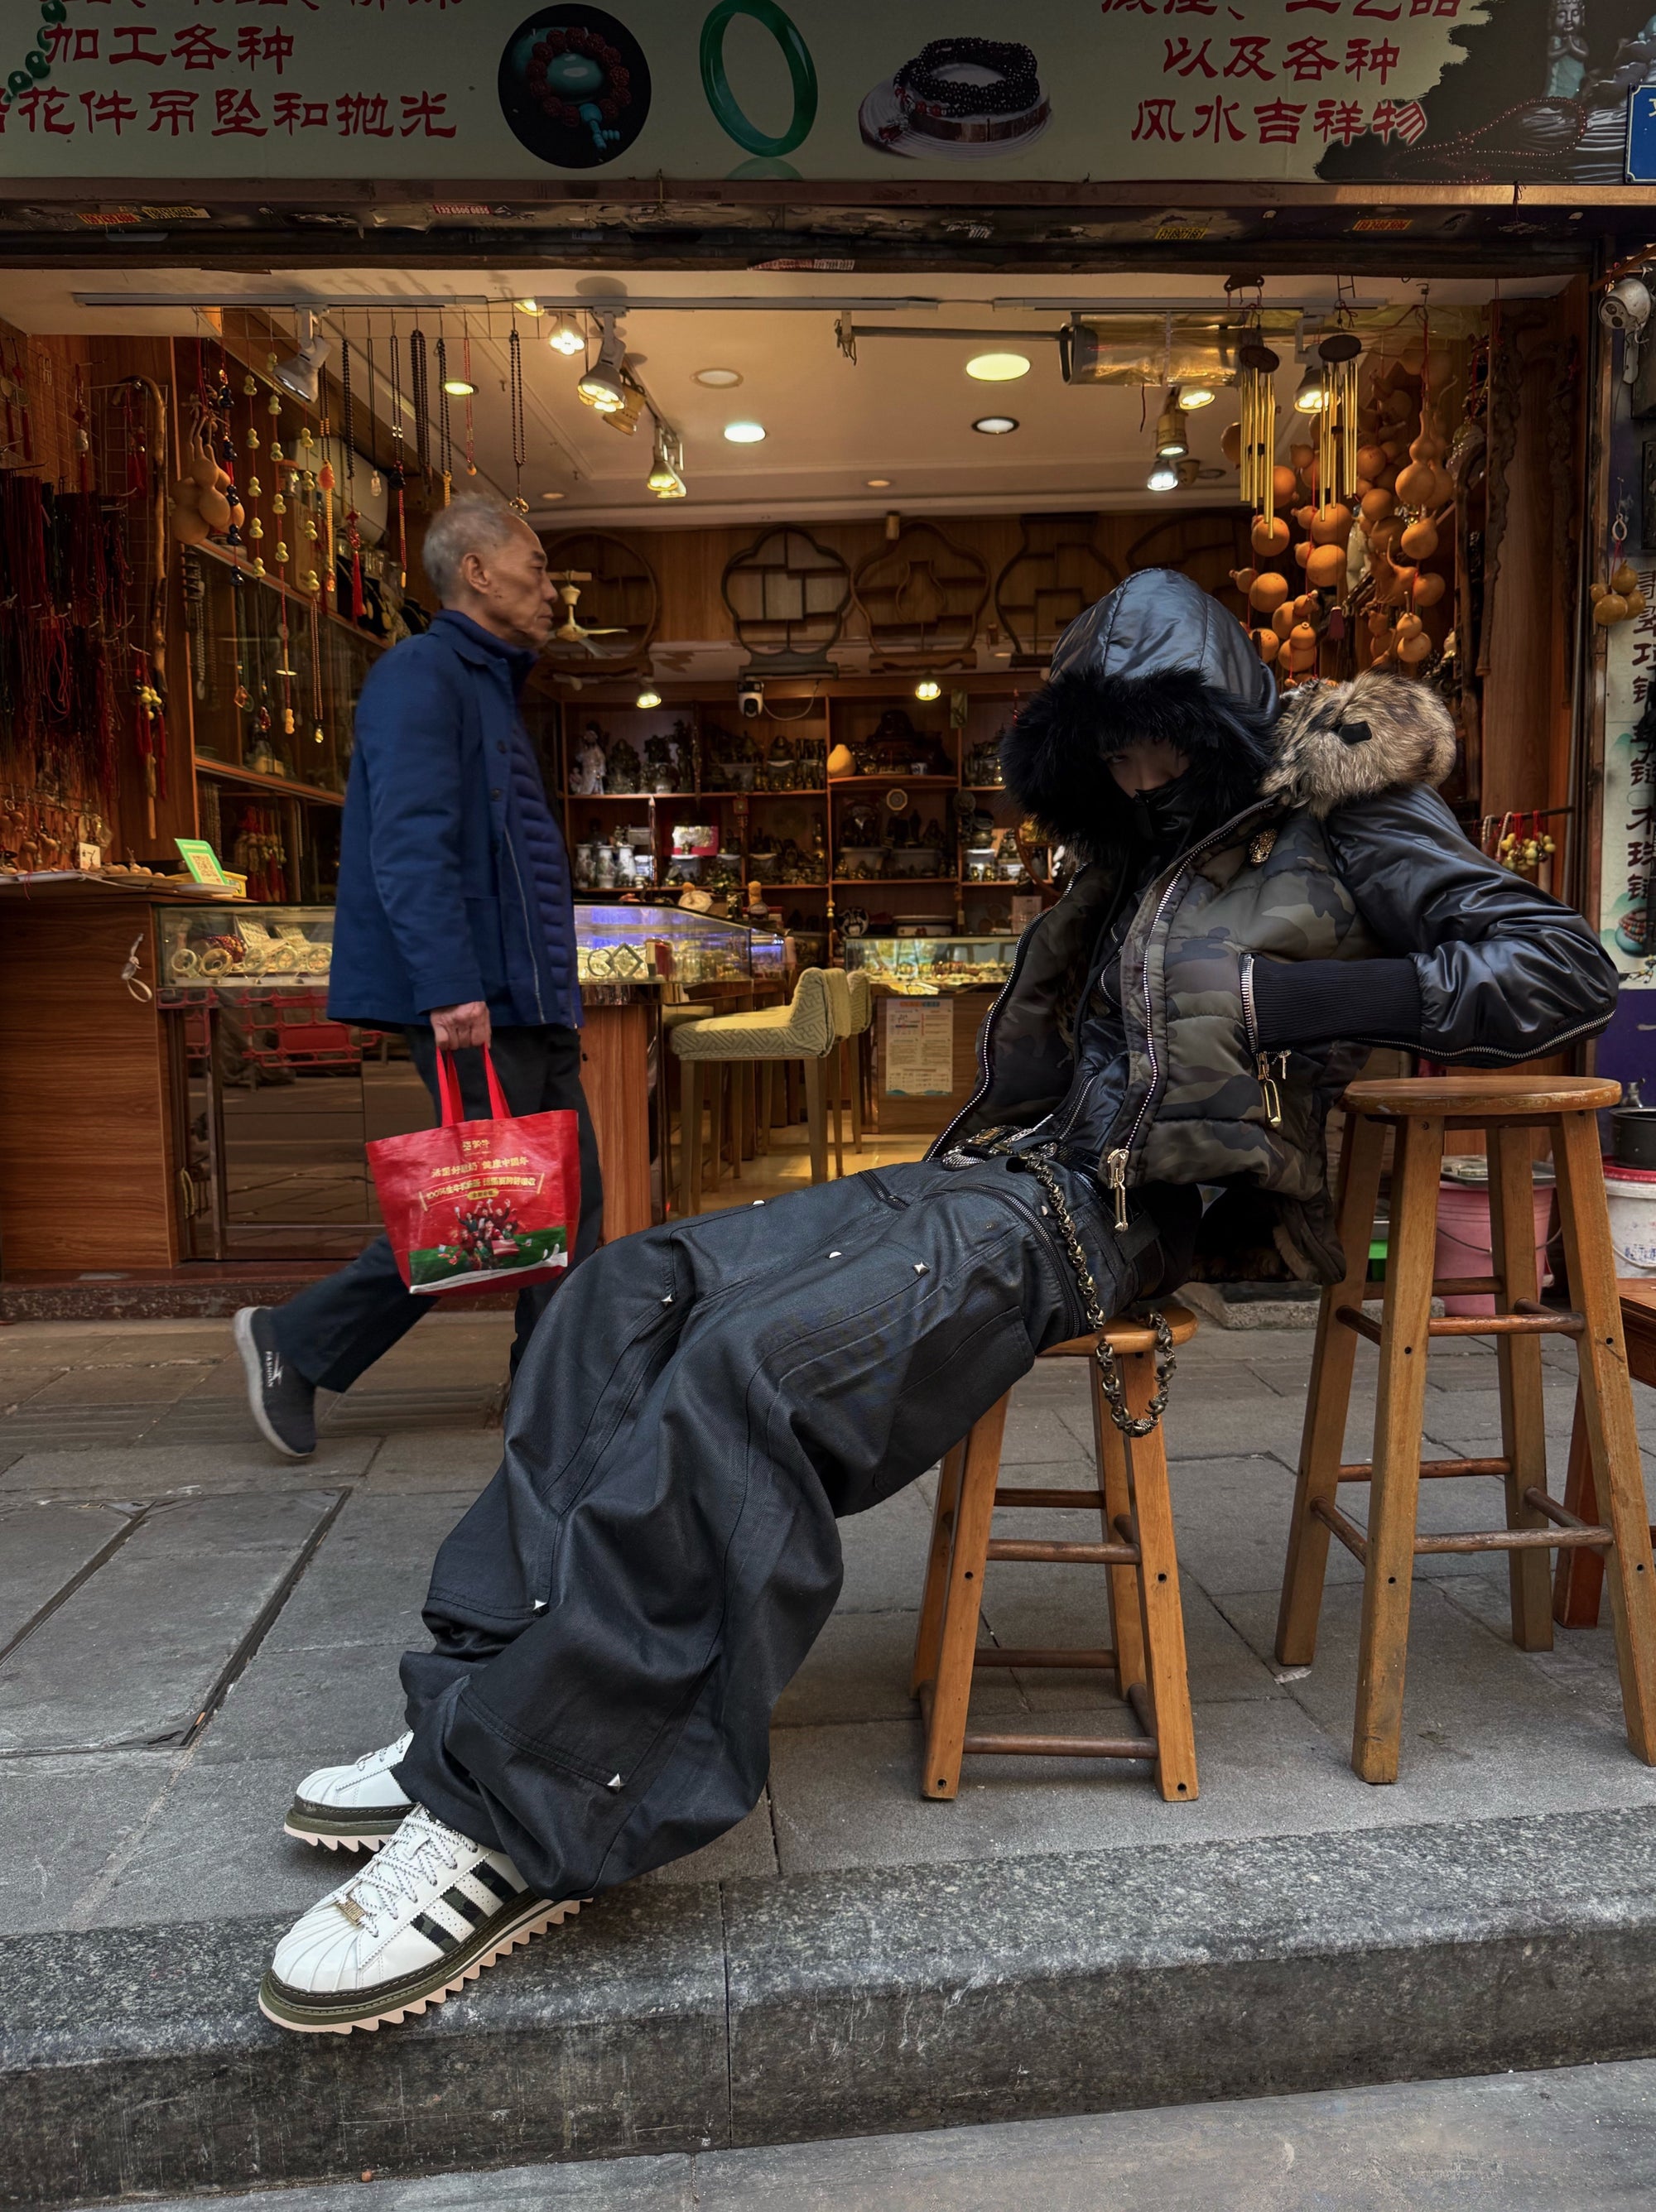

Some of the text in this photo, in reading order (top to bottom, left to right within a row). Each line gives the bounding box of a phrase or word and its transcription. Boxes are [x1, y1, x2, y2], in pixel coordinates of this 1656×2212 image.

[44, 23, 295, 75] 加工各种
[1163, 36, 1401, 86] 以及各种
[0, 86, 458, 138] 花件吊坠和抛光
[1131, 94, 1427, 147] 风水吉祥物
